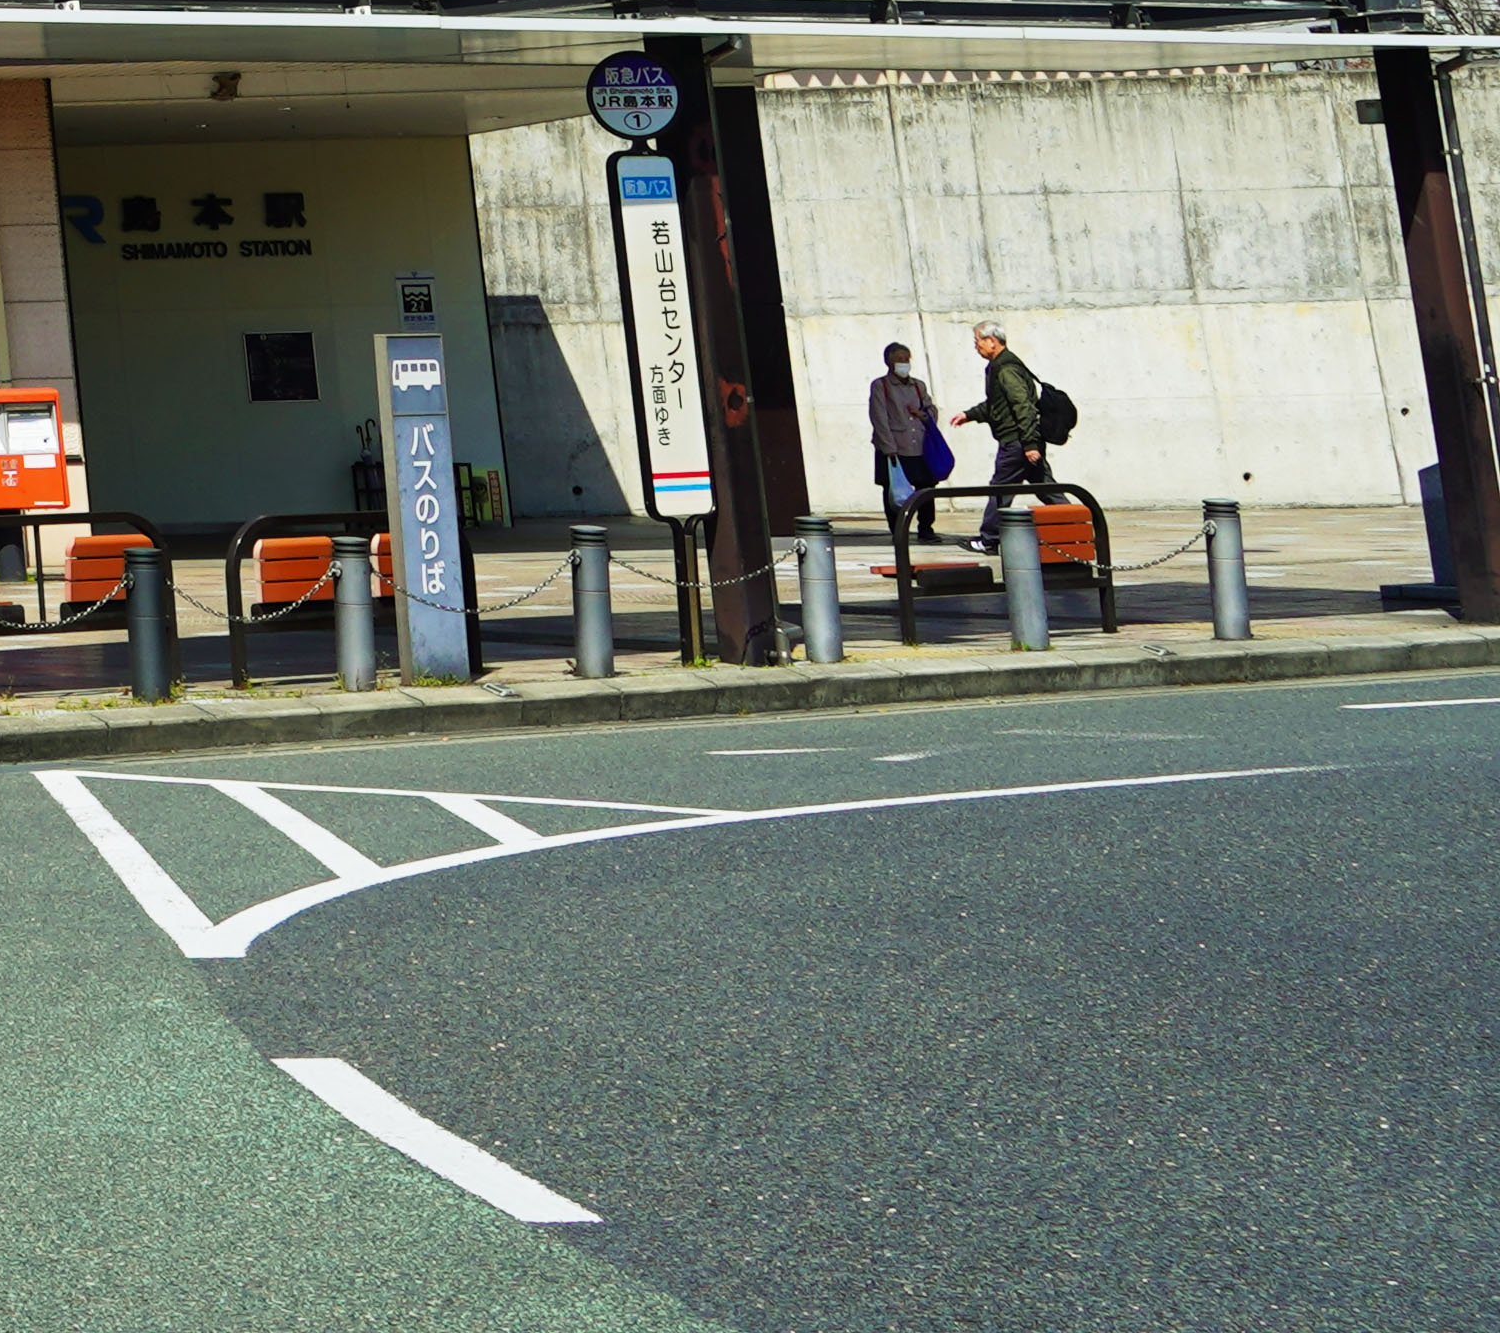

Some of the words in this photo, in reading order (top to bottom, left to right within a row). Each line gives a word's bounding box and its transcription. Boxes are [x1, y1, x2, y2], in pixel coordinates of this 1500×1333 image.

[605, 67, 666, 85] 阪急バス
[596, 95, 674, 109] JR島本駅
[624, 179, 672, 196] 阪急バス
[60, 195, 106, 244] R
[121, 241, 228, 261] SHIMAMOTO
[239, 239, 313, 258] STATION
[652, 221, 685, 410] 若山台センター
[650, 365, 671, 446] 方面ゆき
[410, 423, 446, 595] バスのりば
